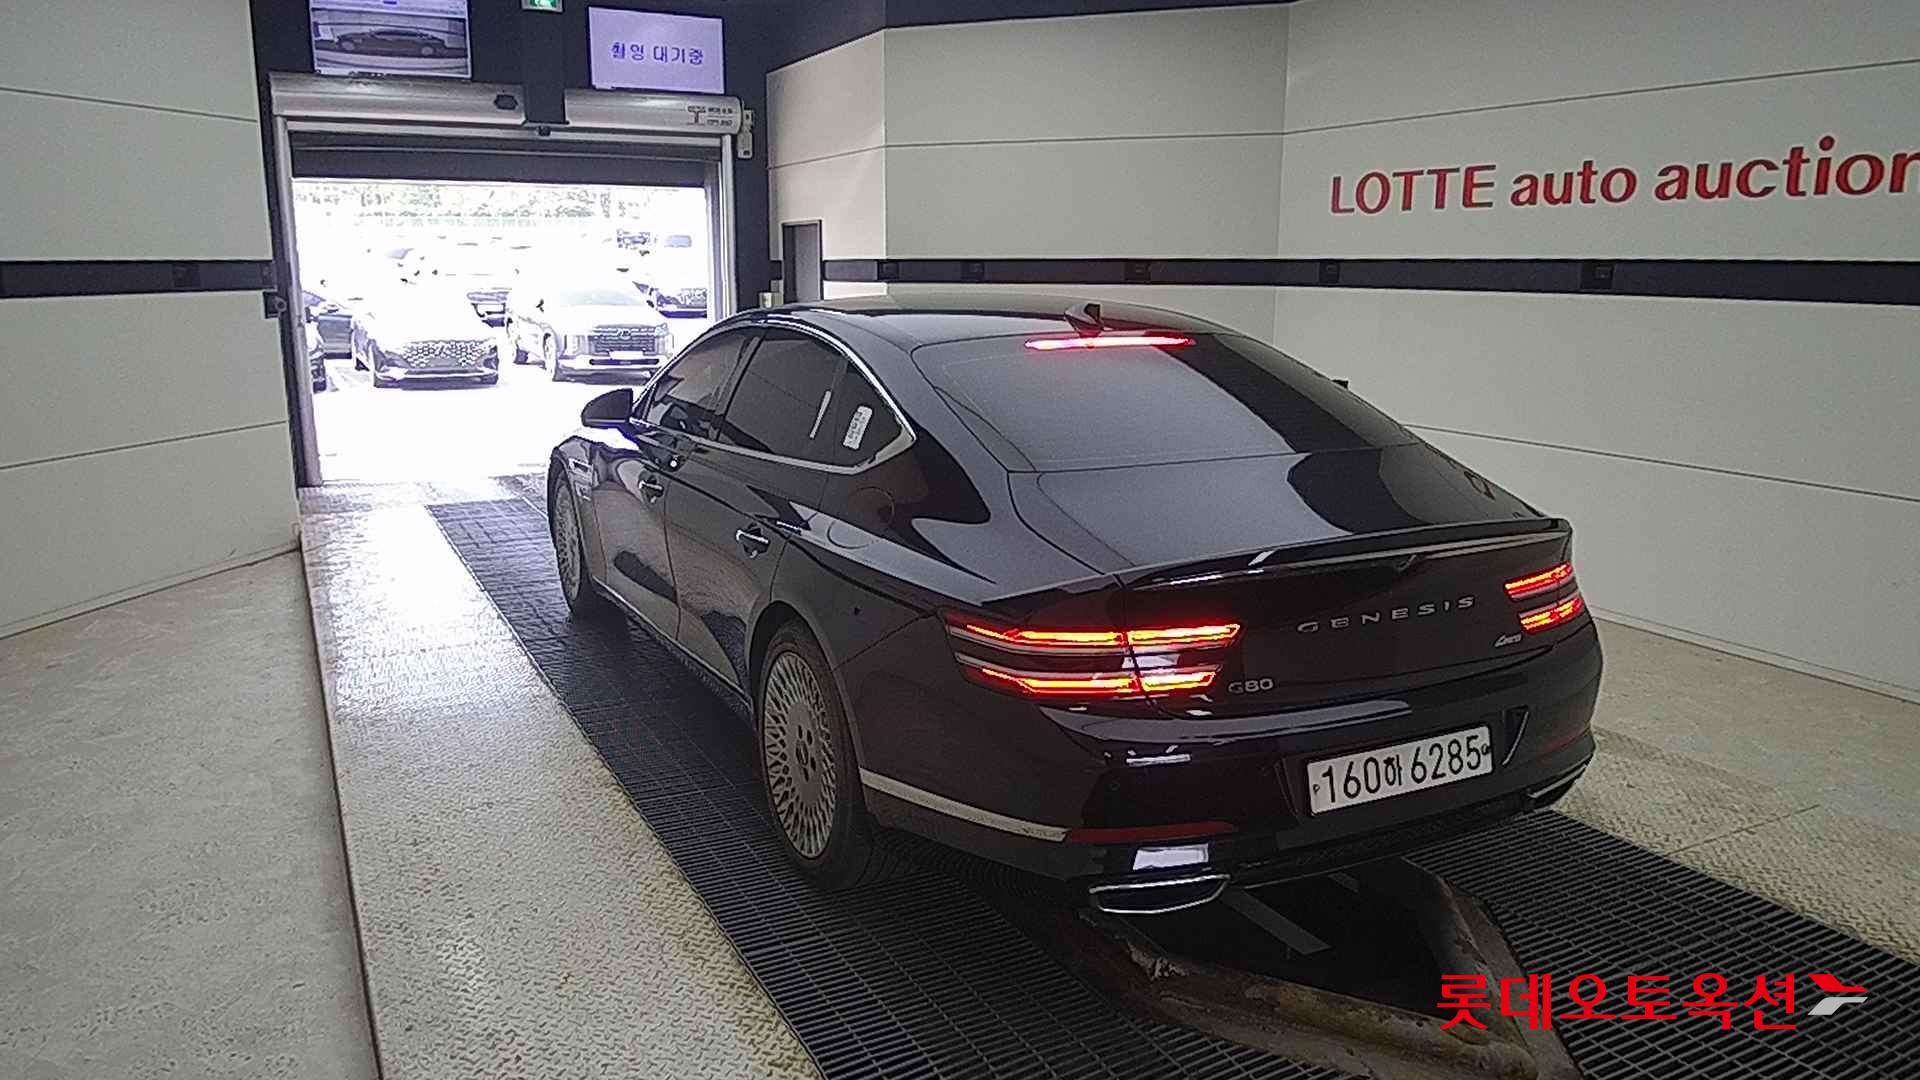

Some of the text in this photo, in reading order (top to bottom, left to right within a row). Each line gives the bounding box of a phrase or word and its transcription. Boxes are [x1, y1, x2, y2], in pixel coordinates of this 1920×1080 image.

[653, 46, 704, 65] 대기중
[1331, 164, 1497, 214] LOTTE
[1510, 160, 1638, 207] auto
[1298, 596, 1475, 634] GENESIS
[1228, 678, 1274, 694] G80
